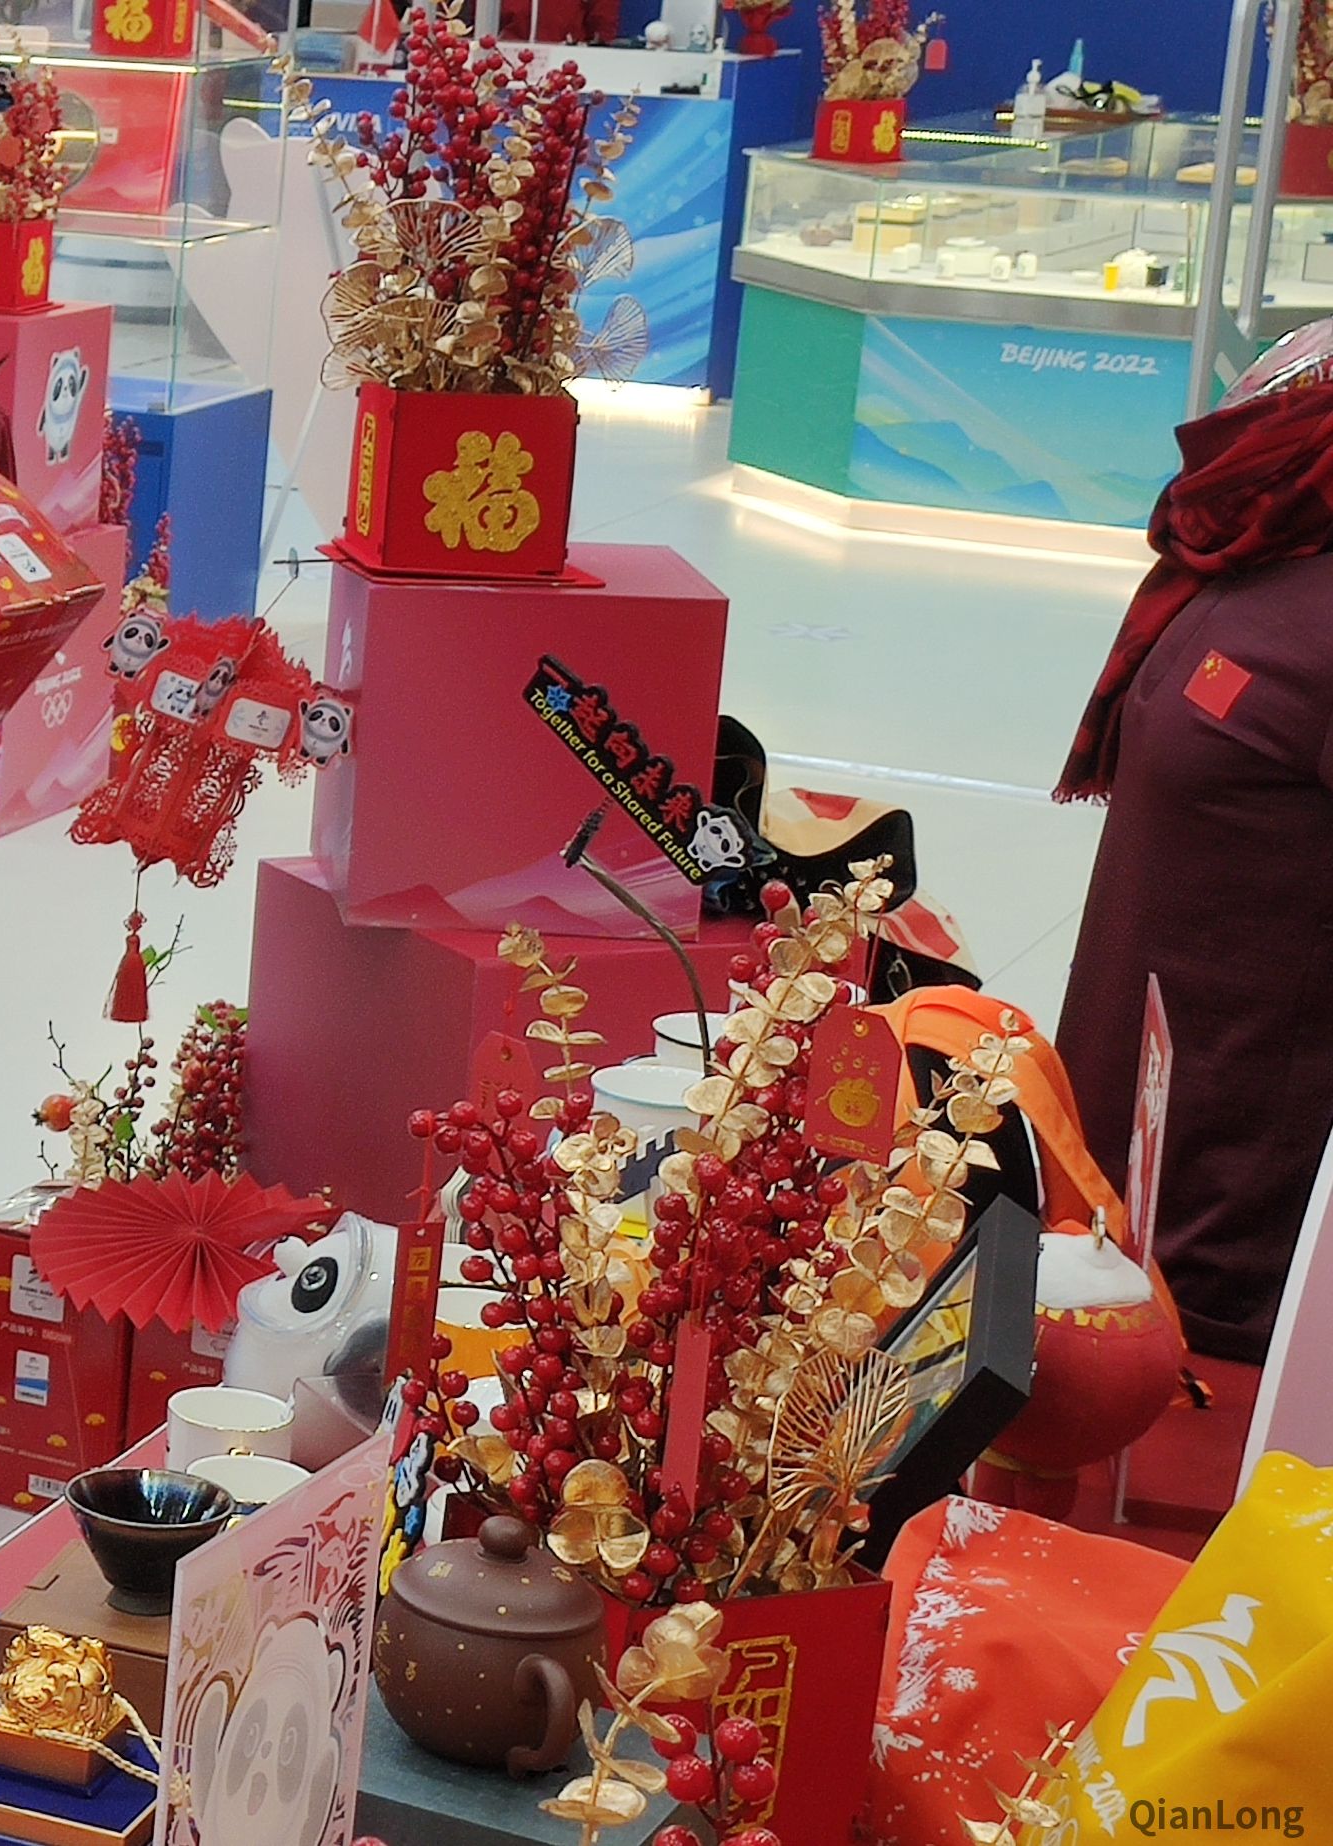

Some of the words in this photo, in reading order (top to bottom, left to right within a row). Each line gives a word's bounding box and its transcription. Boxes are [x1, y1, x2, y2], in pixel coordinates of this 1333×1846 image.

[1000, 342, 1087, 373] BEIJING
[1092, 351, 1159, 375] 2022
[423, 431, 540, 552] 福
[529, 687, 586, 751] Together
[582, 748, 606, 773] for
[601, 769, 616, 786] a
[610, 779, 664, 835] Shared
[657, 829, 703, 882] Future
[541, 662, 694, 834] 一起向未来
